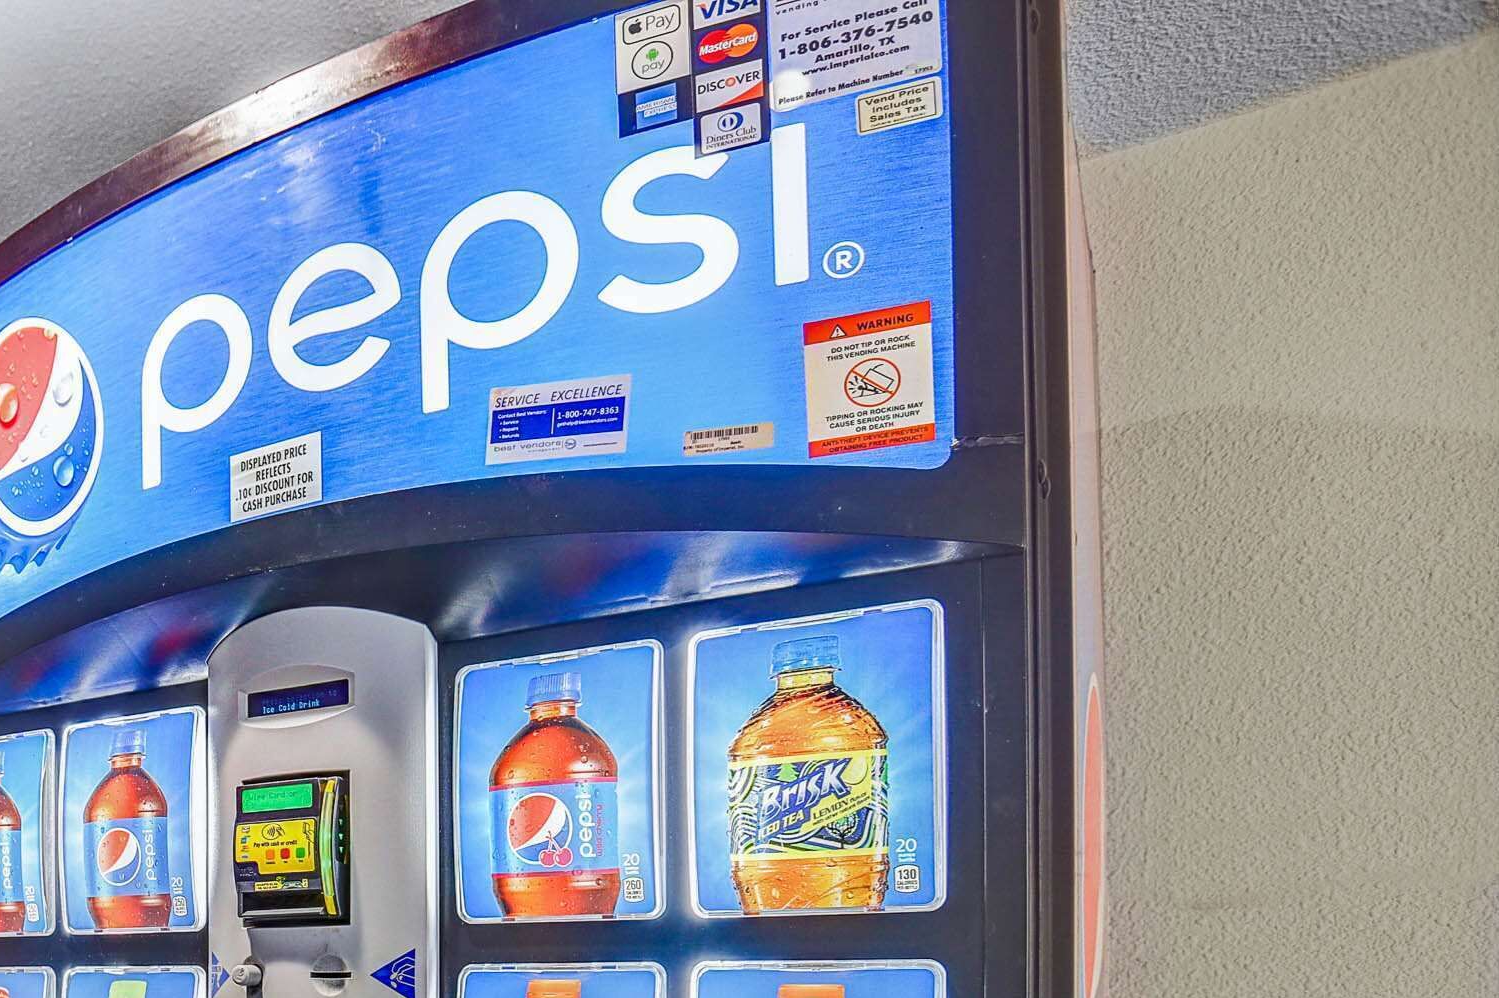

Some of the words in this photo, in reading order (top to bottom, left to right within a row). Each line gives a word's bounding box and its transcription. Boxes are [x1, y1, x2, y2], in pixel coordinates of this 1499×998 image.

[645, 12, 675, 31] Pay
[781, 32, 801, 42] For
[805, 19, 850, 36] Service
[855, 6, 898, 23] Please
[699, 32, 757, 56] MasterCard
[778, 11, 933, 60] 1-806-376-7540
[815, 43, 875, 63] Amarillo,
[878, 35, 896, 46] TX
[641, 60, 665, 74] pay
[802, 44, 910, 76] www.imperialco.com
[698, 71, 760, 95] DISCOVER
[778, 94, 804, 105] Please
[805, 88, 826, 98] Refer
[838, 77, 870, 90] Machine
[872, 69, 904, 82] Number
[865, 93, 895, 105] Vend
[898, 85, 929, 98] Price
[869, 110, 901, 123] Sales
[906, 104, 926, 115] Tax
[706, 133, 733, 144] Diners
[736, 126, 757, 138] Club
[141, 123, 809, 492] pepsi
[857, 313, 914, 331] WARNING
[827, 353, 844, 362] THIS
[845, 347, 879, 359] VENDING
[881, 340, 916, 353] MACHINE
[831, 346, 843, 354] DO
[844, 343, 860, 352] NOT
[861, 341, 873, 349] TIP
[875, 338, 886, 346] OR
[888, 334, 910, 344] ROCK
[494, 393, 541, 408] SERVICE
[550, 384, 623, 402] EXCELLENCE
[557, 406, 619, 420] 1-800-747-8363
[825, 412, 855, 422] TIPPING
[856, 410, 868, 418] OR
[870, 404, 906, 415] ROCKING
[907, 401, 924, 409] MAY
[829, 420, 855, 429] CAUSE
[857, 414, 891, 425] SERIOUS
[892, 409, 921, 419] INJURY
[863, 432, 889, 441] DEVICE
[891, 426, 928, 437] PREVENTS
[868, 422, 894, 431] DEATH
[494, 444, 516, 453] best
[520, 440, 562, 450] vendors
[829, 443, 867, 453] OBTAINING
[869, 439, 887, 447] FREE
[889, 434, 923, 444] PRODUCT
[241, 451, 282, 472] DISPLAYED
[284, 444, 307, 460] PRICE
[255, 462, 291, 481] REFLECTS
[255, 476, 295, 495] DISCOUNT
[297, 471, 313, 485] FOR
[242, 498, 262, 513] CASH
[265, 487, 307, 508] PURCHASE
[263, 706, 275, 715] Ice
[278, 703, 295, 712] Cold
[299, 699, 320, 709] Drink
[783, 810, 804, 828] TEA
[813, 799, 848, 819] LEMON
[575, 793, 597, 858] pepsi
[143, 828, 157, 881] pepsi
[895, 838, 917, 853] 20
[0, 842, 13, 889] pepsi
[622, 853, 639, 866] 20
[898, 869, 917, 880] 130
